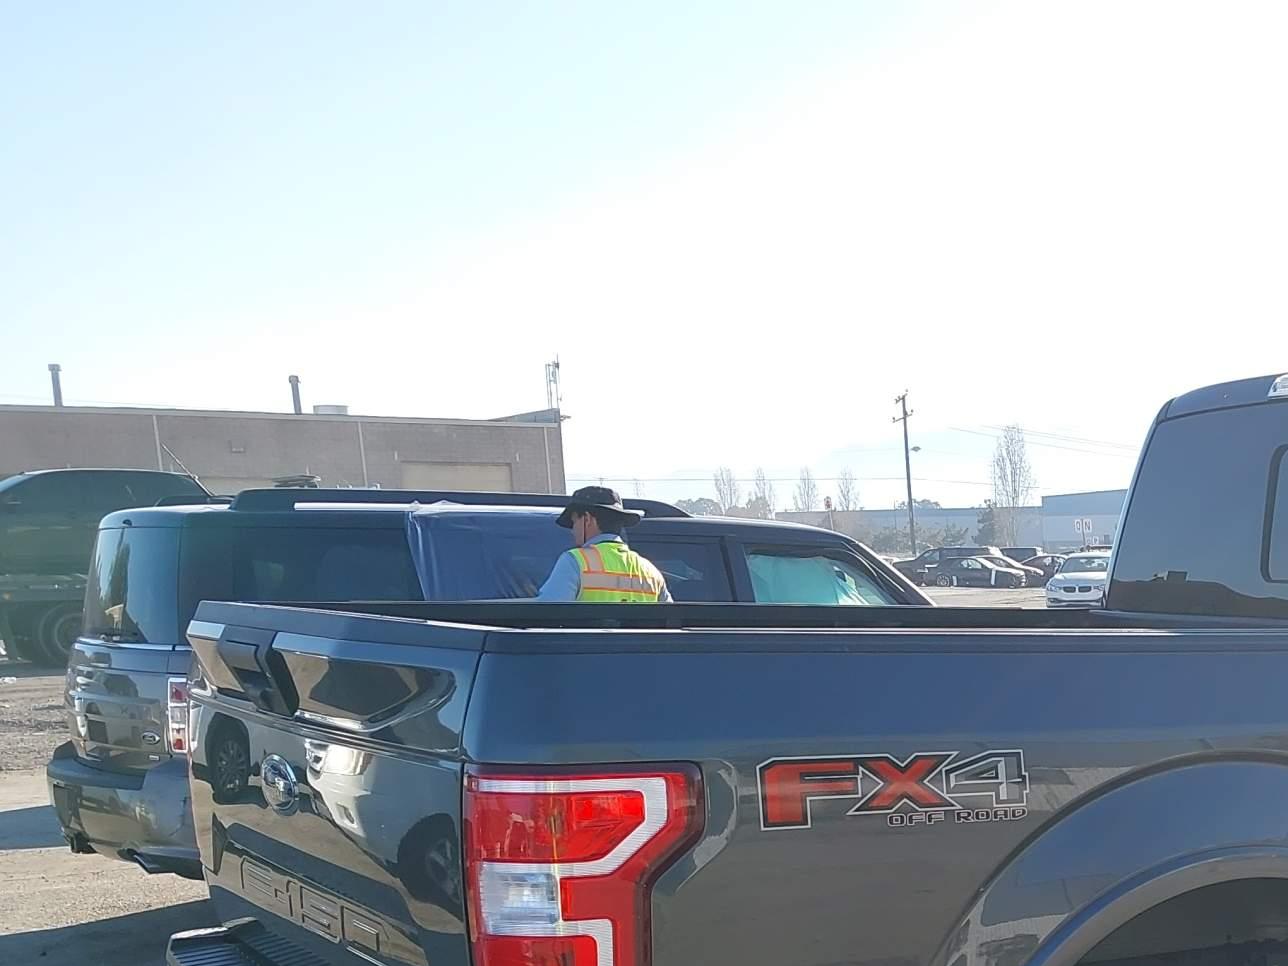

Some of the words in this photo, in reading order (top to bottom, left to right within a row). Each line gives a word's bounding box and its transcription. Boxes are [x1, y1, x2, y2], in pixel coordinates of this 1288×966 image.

[756, 749, 1029, 831] FX4
[887, 812, 945, 827] OFF
[955, 807, 1028, 824] ROAD
